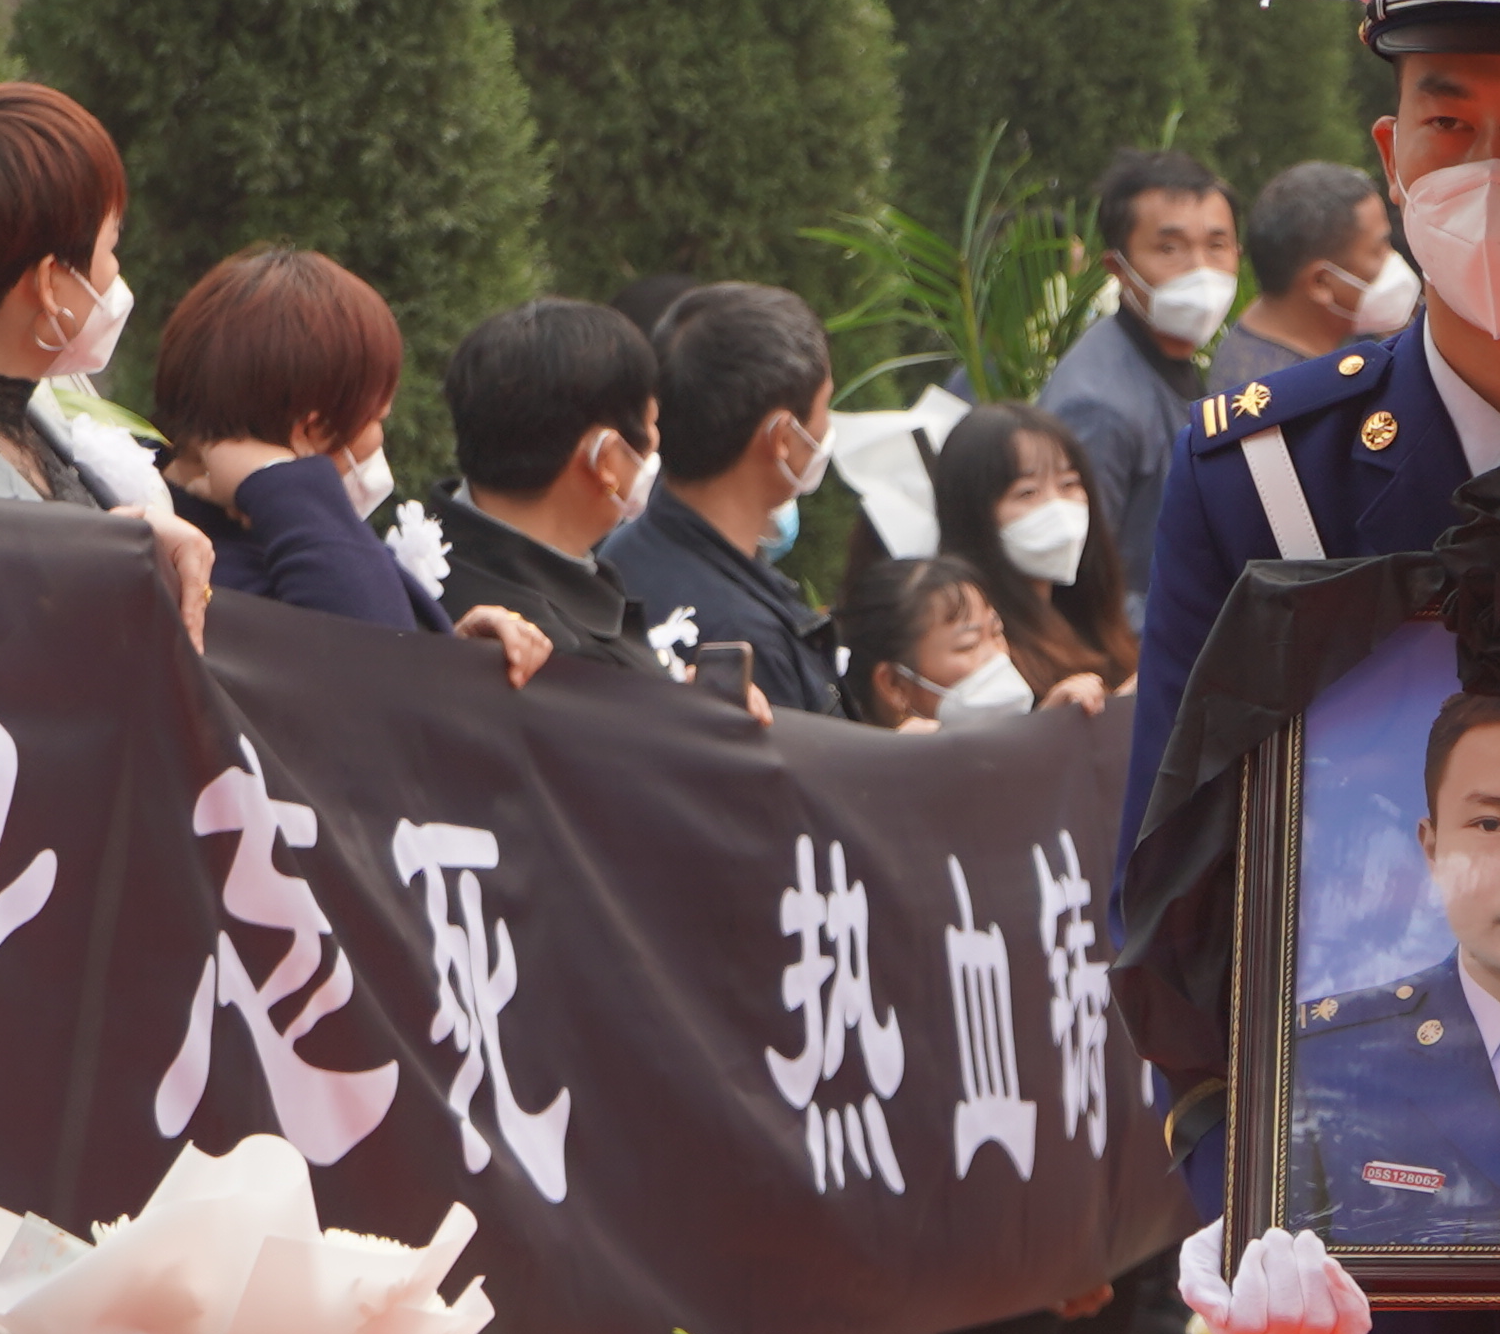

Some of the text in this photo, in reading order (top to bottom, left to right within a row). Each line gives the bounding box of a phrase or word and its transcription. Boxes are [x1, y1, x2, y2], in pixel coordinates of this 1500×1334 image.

[765, 829, 1154, 1195] 热血铸
[1366, 1167, 1440, 1188] 05S128062
